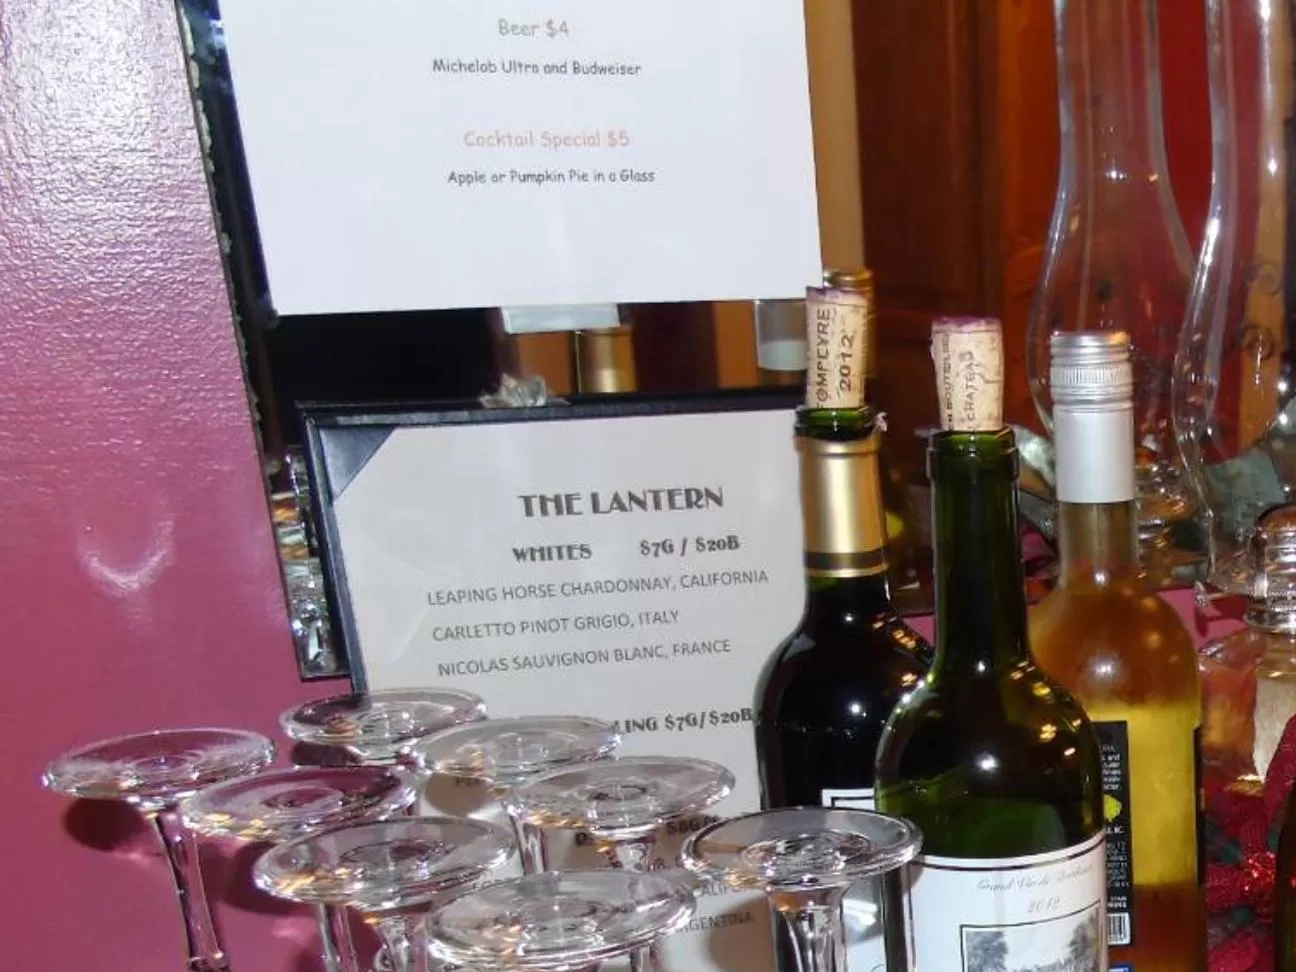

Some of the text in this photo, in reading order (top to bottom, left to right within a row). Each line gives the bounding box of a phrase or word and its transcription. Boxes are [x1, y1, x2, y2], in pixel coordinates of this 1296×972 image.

[498, 17, 569, 39] Beer $4
[432, 58, 642, 76] Michelob Ultra and Budweiser
[464, 129, 630, 151] Cocktail Special $5
[447, 168, 656, 187] Apple or Pumpkin Pie in a Glass
[518, 486, 724, 518] THE LANTERN
[512, 543, 593, 563] WHITES
[640, 537, 676, 558] $7G
[695, 534, 741, 554] $20B
[427, 569, 769, 607] LEAPING HORSE CHARDONNAY, CALIFORNIA
[432, 609, 680, 643] CARLETTO PINOT GRIGIO, ITALY
[438, 638, 732, 678] NICOLAS SAUVIGNON BLANC, FRANCE
